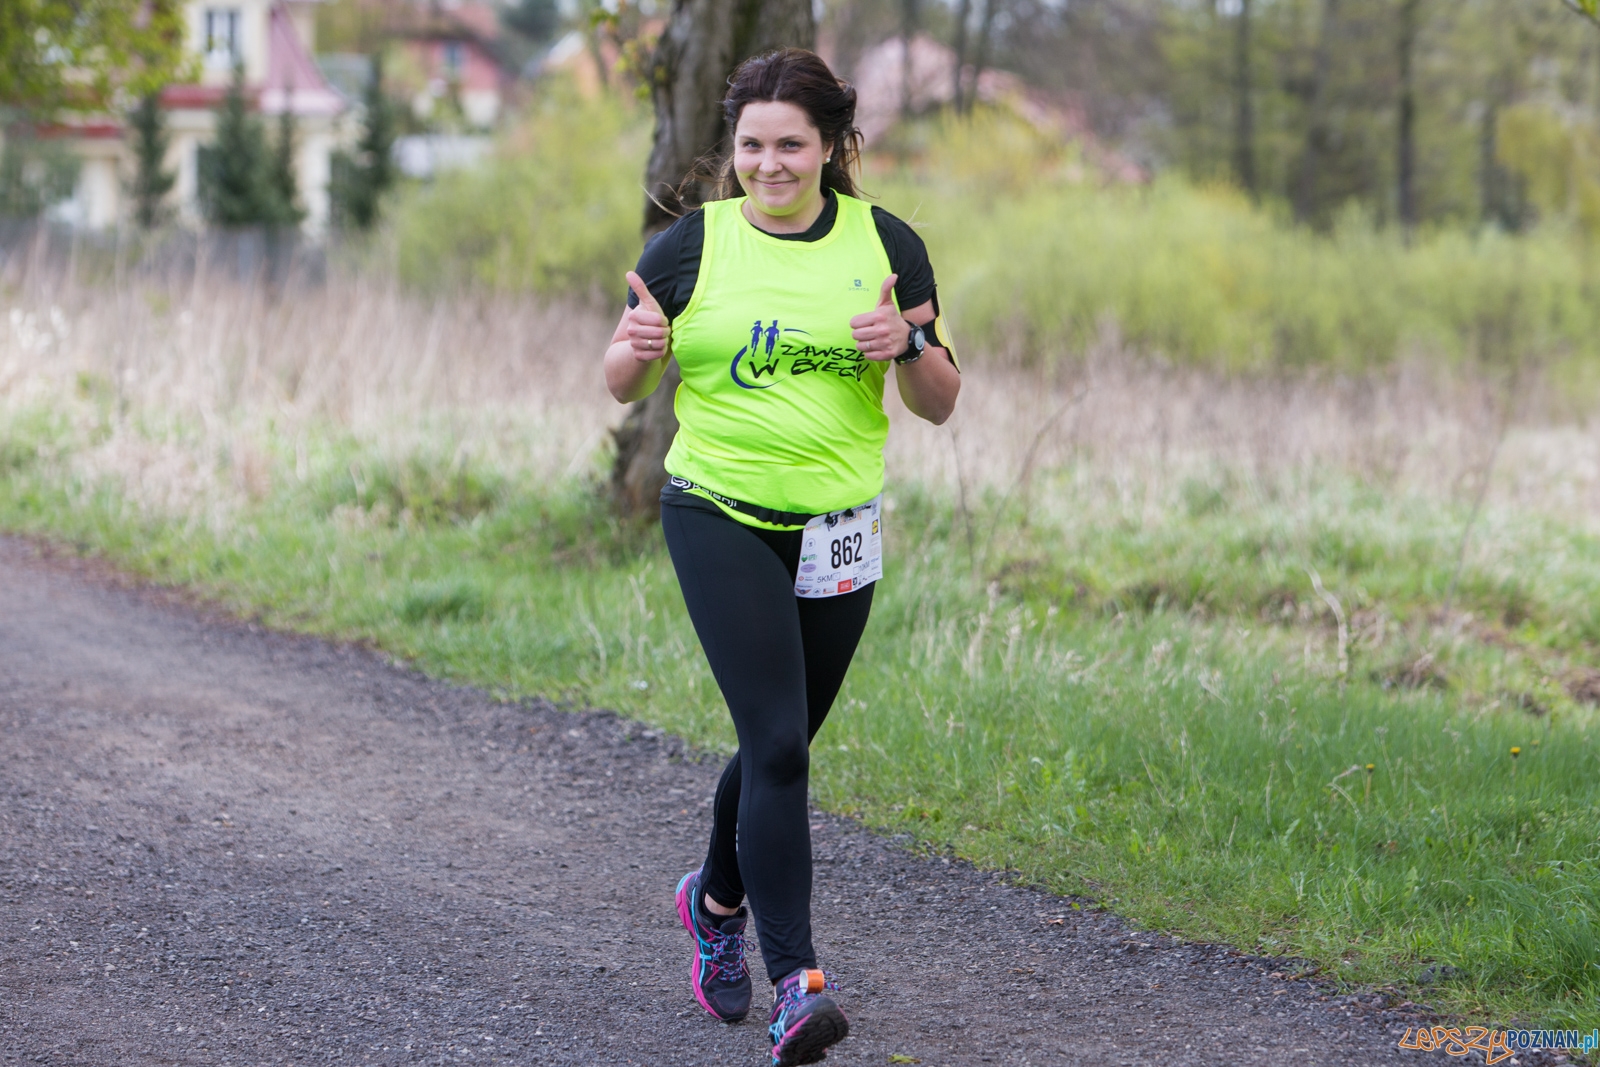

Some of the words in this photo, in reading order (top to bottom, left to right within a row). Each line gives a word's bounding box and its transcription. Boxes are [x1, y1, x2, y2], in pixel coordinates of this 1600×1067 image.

[781, 345, 865, 362] ZAWSZE
[749, 358, 779, 379] W
[831, 532, 862, 569] 862
[817, 574, 833, 584] 5KM
